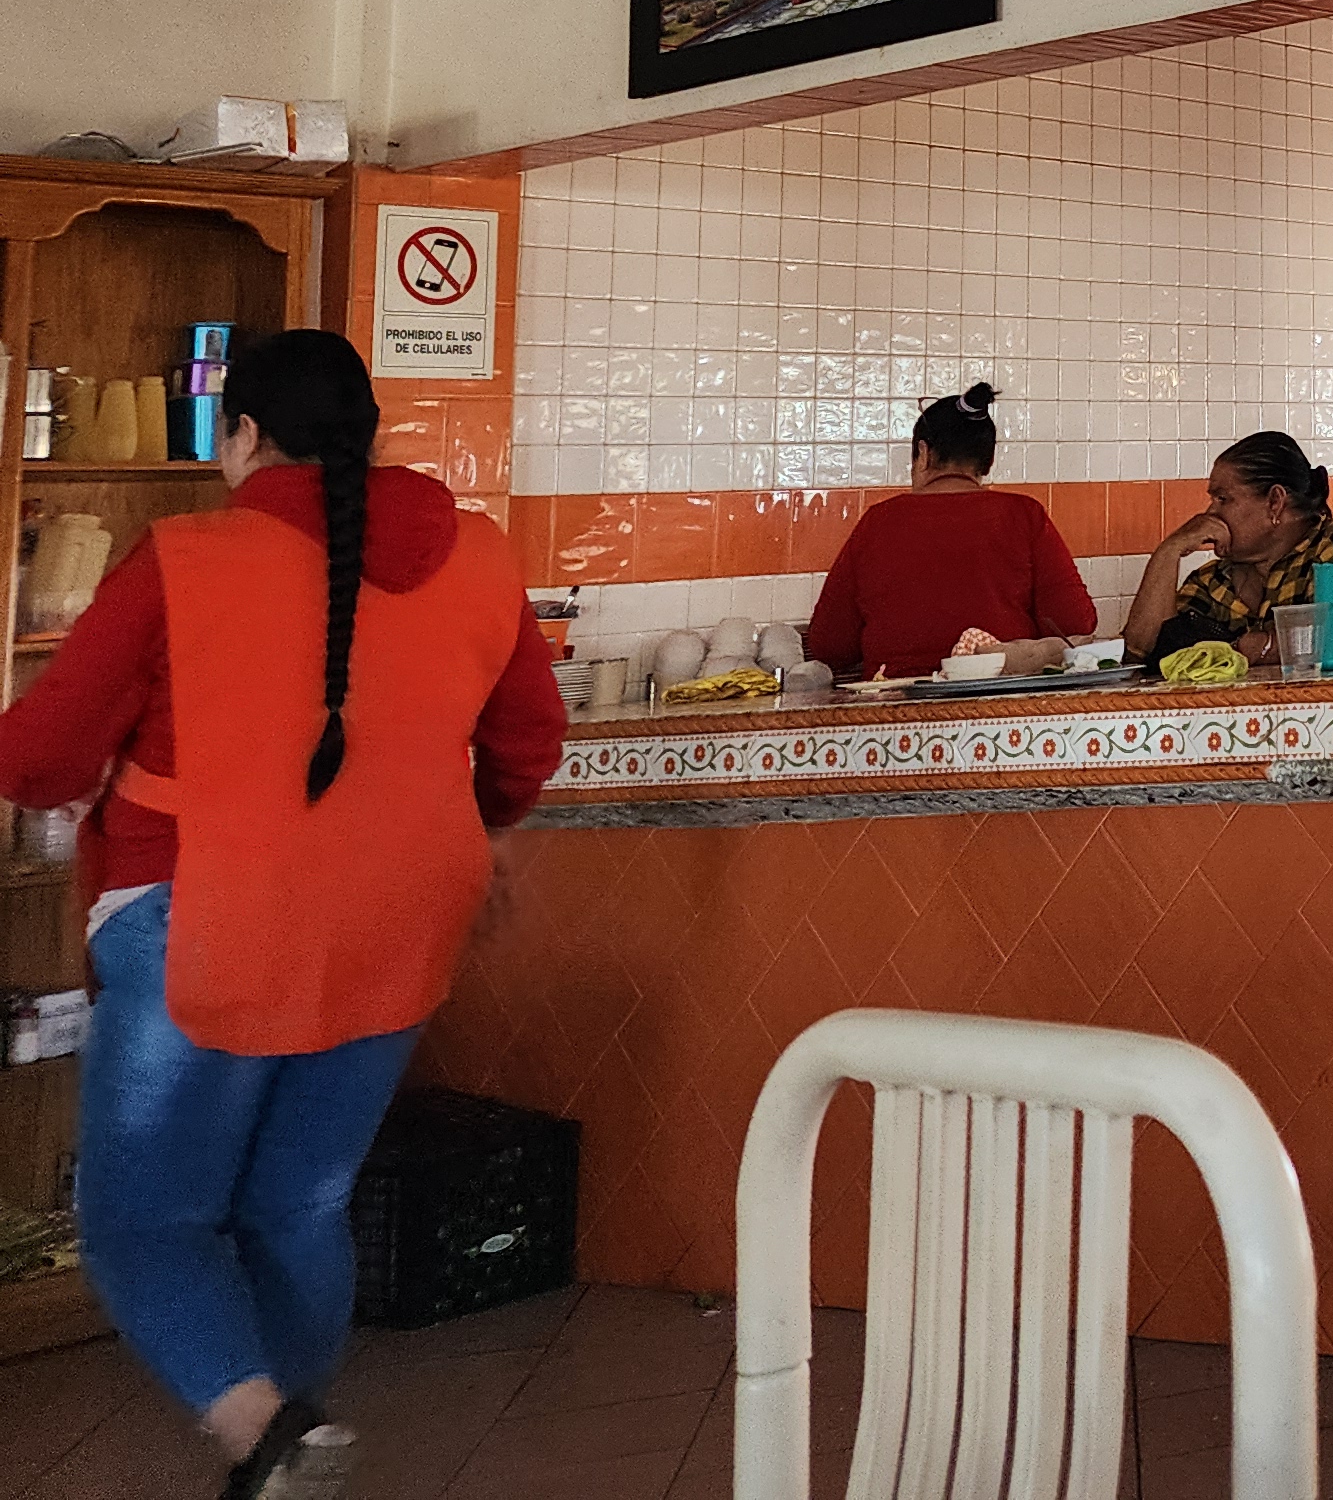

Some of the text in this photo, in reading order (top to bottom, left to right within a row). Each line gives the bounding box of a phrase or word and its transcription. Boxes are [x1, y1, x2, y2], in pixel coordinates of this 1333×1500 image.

[385, 328, 482, 342] PROHIBIDO EL USO
[395, 343, 473, 355] DE CELULARES
